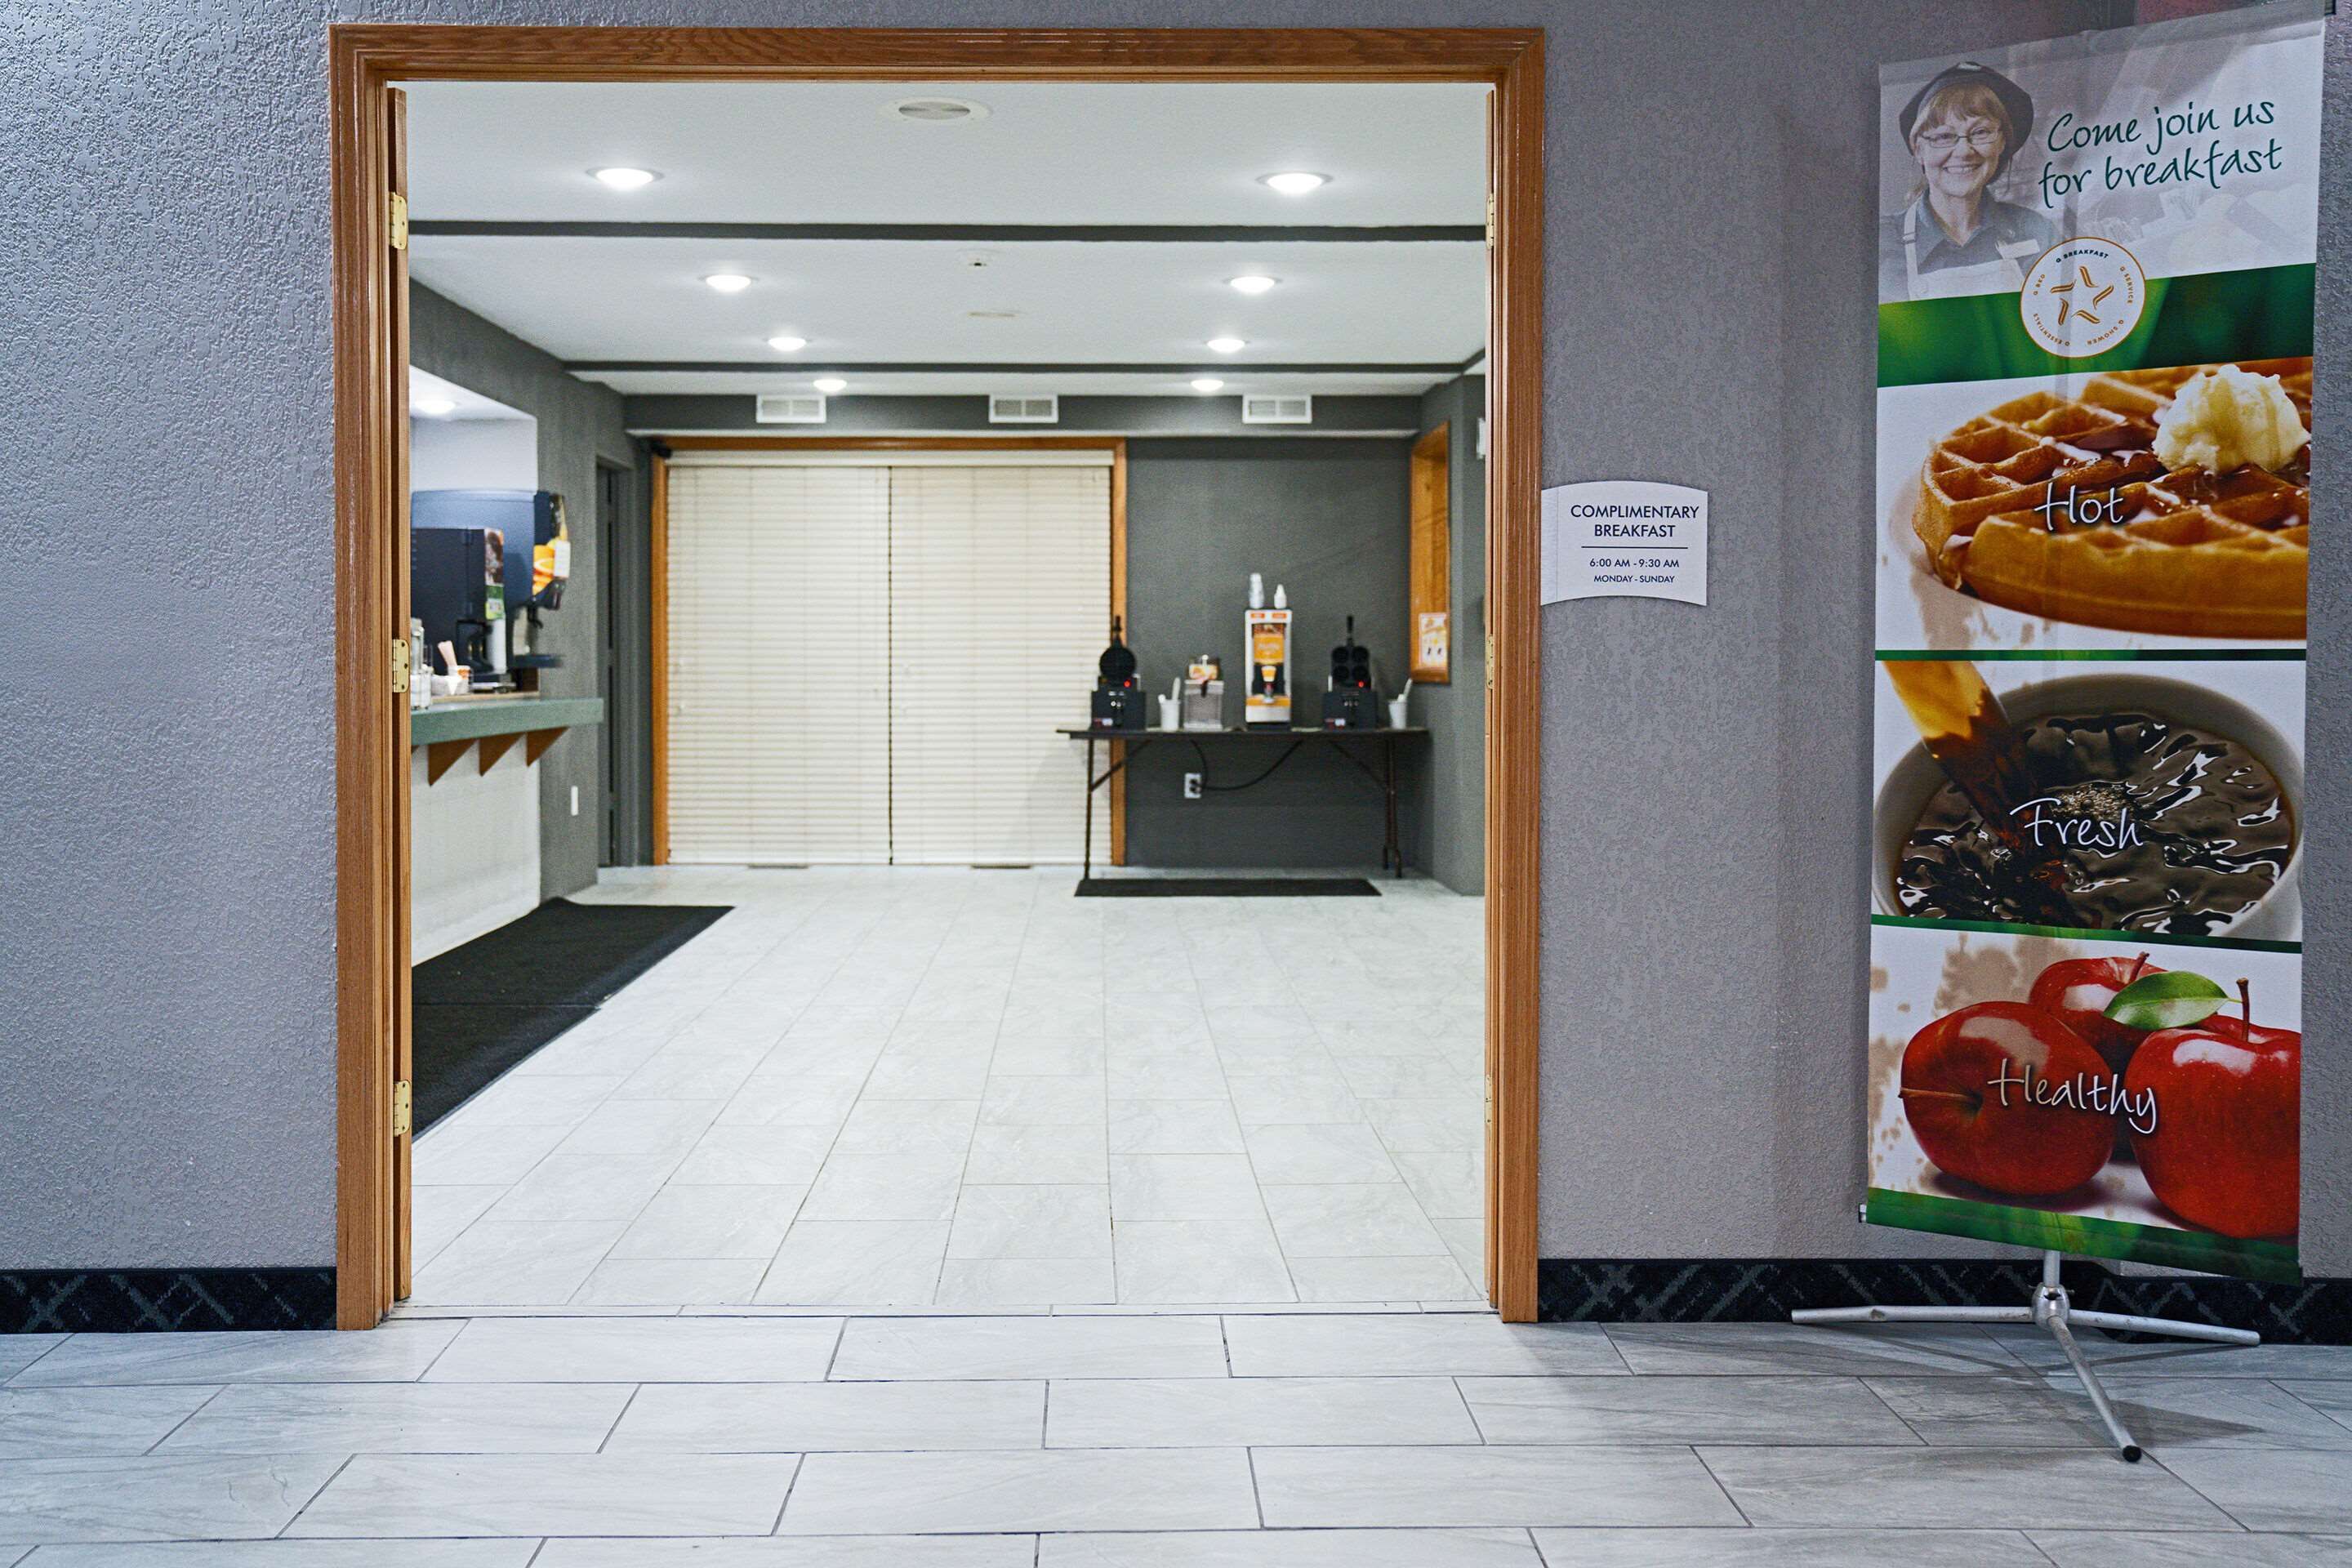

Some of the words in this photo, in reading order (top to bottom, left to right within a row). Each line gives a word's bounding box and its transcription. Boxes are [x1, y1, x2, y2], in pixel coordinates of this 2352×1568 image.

[2047, 113, 2141, 152] Come
[2146, 101, 2220, 155] join
[2234, 101, 2274, 128] us
[2038, 161, 2091, 209] for
[2105, 138, 2283, 190] breakfast
[2063, 249, 2109, 259] BREAKFAST
[2124, 274, 2134, 304] SERVICE
[2033, 313, 2062, 345] ESSENTIALS
[2087, 326, 2118, 345] SHOWER
[1570, 505, 1699, 519] COMPLIMENTARY
[2034, 482, 2124, 531] Hot
[1594, 524, 1676, 537] BREAKFAST
[1589, 558, 1611, 568] 6:00
[1615, 559, 1630, 568] AM
[1638, 559, 1660, 568] 9:30
[1664, 559, 1680, 568] AM
[1640, 575, 1675, 583] SUNDAY
[2010, 798, 2144, 849] Fresh
[1987, 1057, 2158, 1134] Healthy
